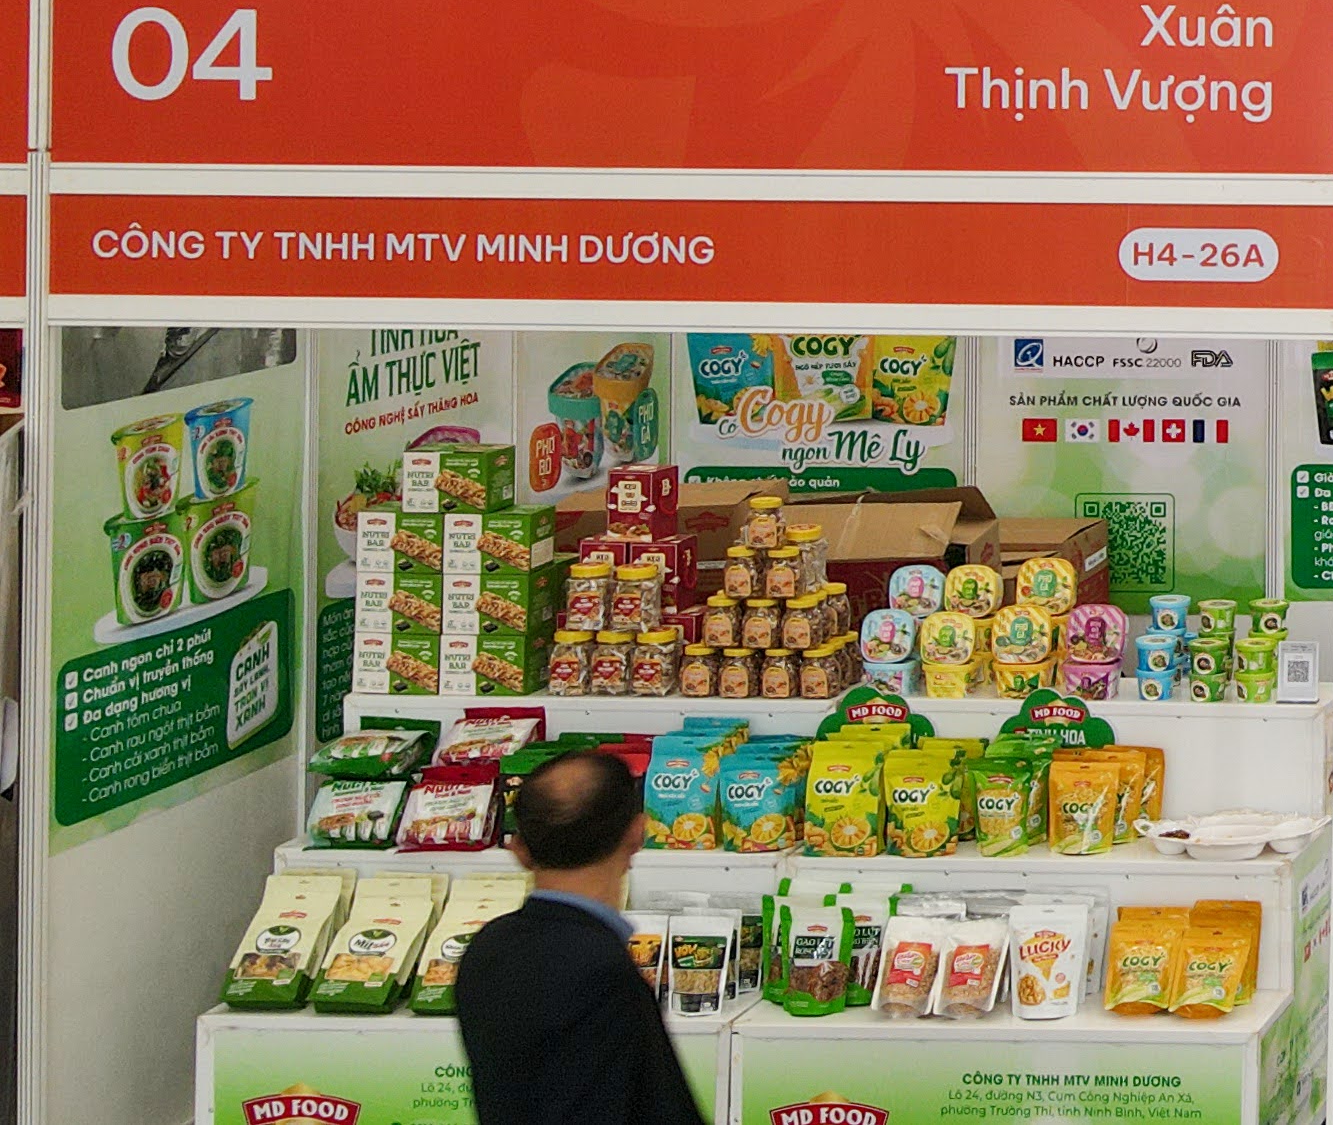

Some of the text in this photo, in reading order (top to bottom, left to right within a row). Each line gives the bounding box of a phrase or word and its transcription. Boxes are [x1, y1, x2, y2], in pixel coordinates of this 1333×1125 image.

[1140, 3, 1274, 49] Xuân
[111, 6, 273, 102] 04
[944, 67, 1274, 123] Thịnh Vượng
[92, 221, 715, 266] CÔNG TY TNHH MTV MINH DƯƠNG
[1132, 241, 1265, 268] H4-26A
[792, 336, 853, 357] COGY
[700, 357, 744, 377] COGY
[879, 356, 923, 376] COGY
[1052, 349, 1234, 368] HACCP FSSC 22000 FDA
[345, 338, 481, 407] ẨM THỰC VIỆT
[1009, 390, 1242, 410] SẢN PHẨM CHẤT LƯỢNG QUỐC GIA
[739, 386, 832, 442] Cogy
[781, 428, 925, 471] ngon Mê Ly
[82, 628, 212, 682] Canh ngon chỉ 2 phút
[851, 704, 903, 719] MD FOOD
[653, 773, 694, 791] COGY
[814, 778, 855, 795] COGY
[1018, 938, 1072, 961] LUCKY
[962, 1071, 1182, 1088] CÔNG TY TNHH MTV MINH DƯƠNG
[252, 1098, 349, 1121] MD FOOD
